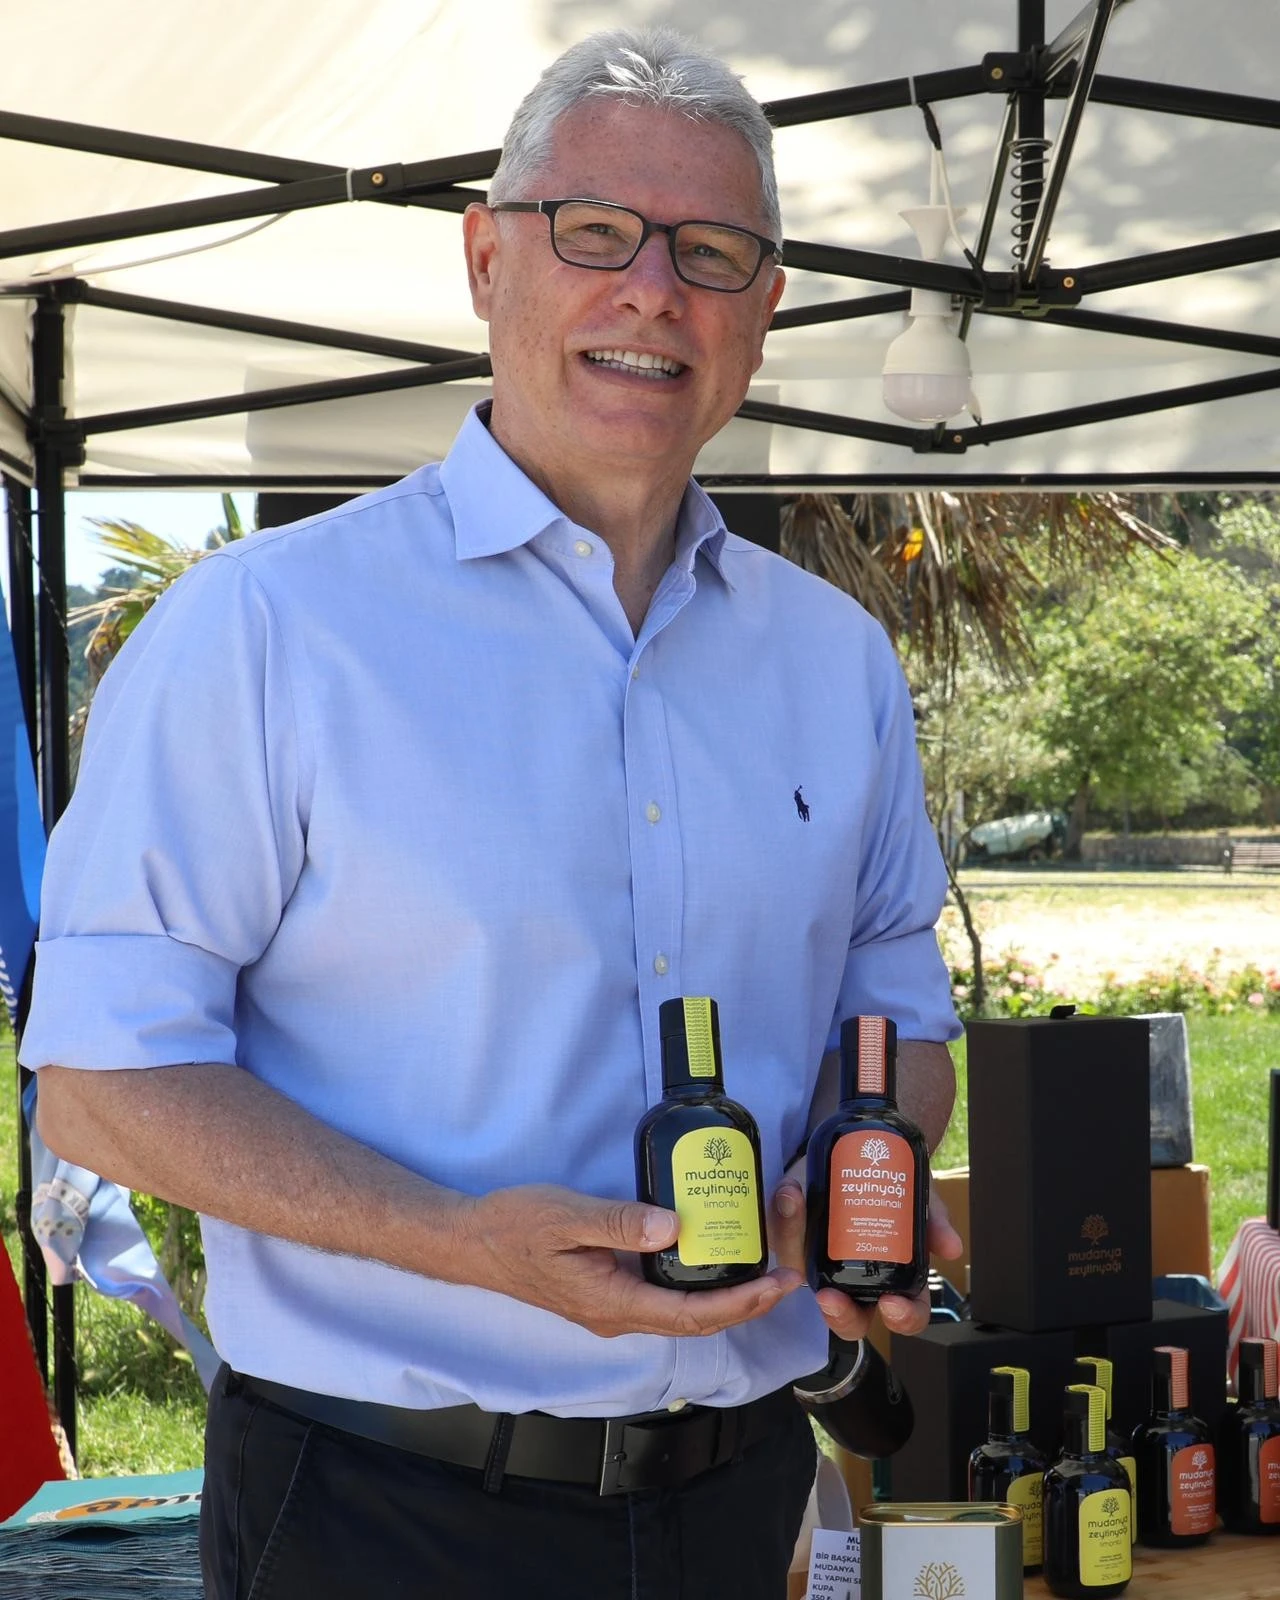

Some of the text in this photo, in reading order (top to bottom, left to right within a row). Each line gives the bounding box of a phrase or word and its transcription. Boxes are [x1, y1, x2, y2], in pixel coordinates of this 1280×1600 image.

[685, 1168, 749, 1183] mudanya
[841, 1167, 906, 1184] mudanya
[687, 1182, 750, 1197] zeytinyağı
[841, 1183, 905, 1198] zeytinyağı
[703, 1200, 739, 1209] limonlu
[1068, 1248, 1122, 1262] mudanya
[814, 1563, 855, 1573] MUDANYA
[813, 1573, 823, 1581] EL
[825, 1574, 852, 1584] YAPIMI
[812, 1584, 835, 1592] KUPA
